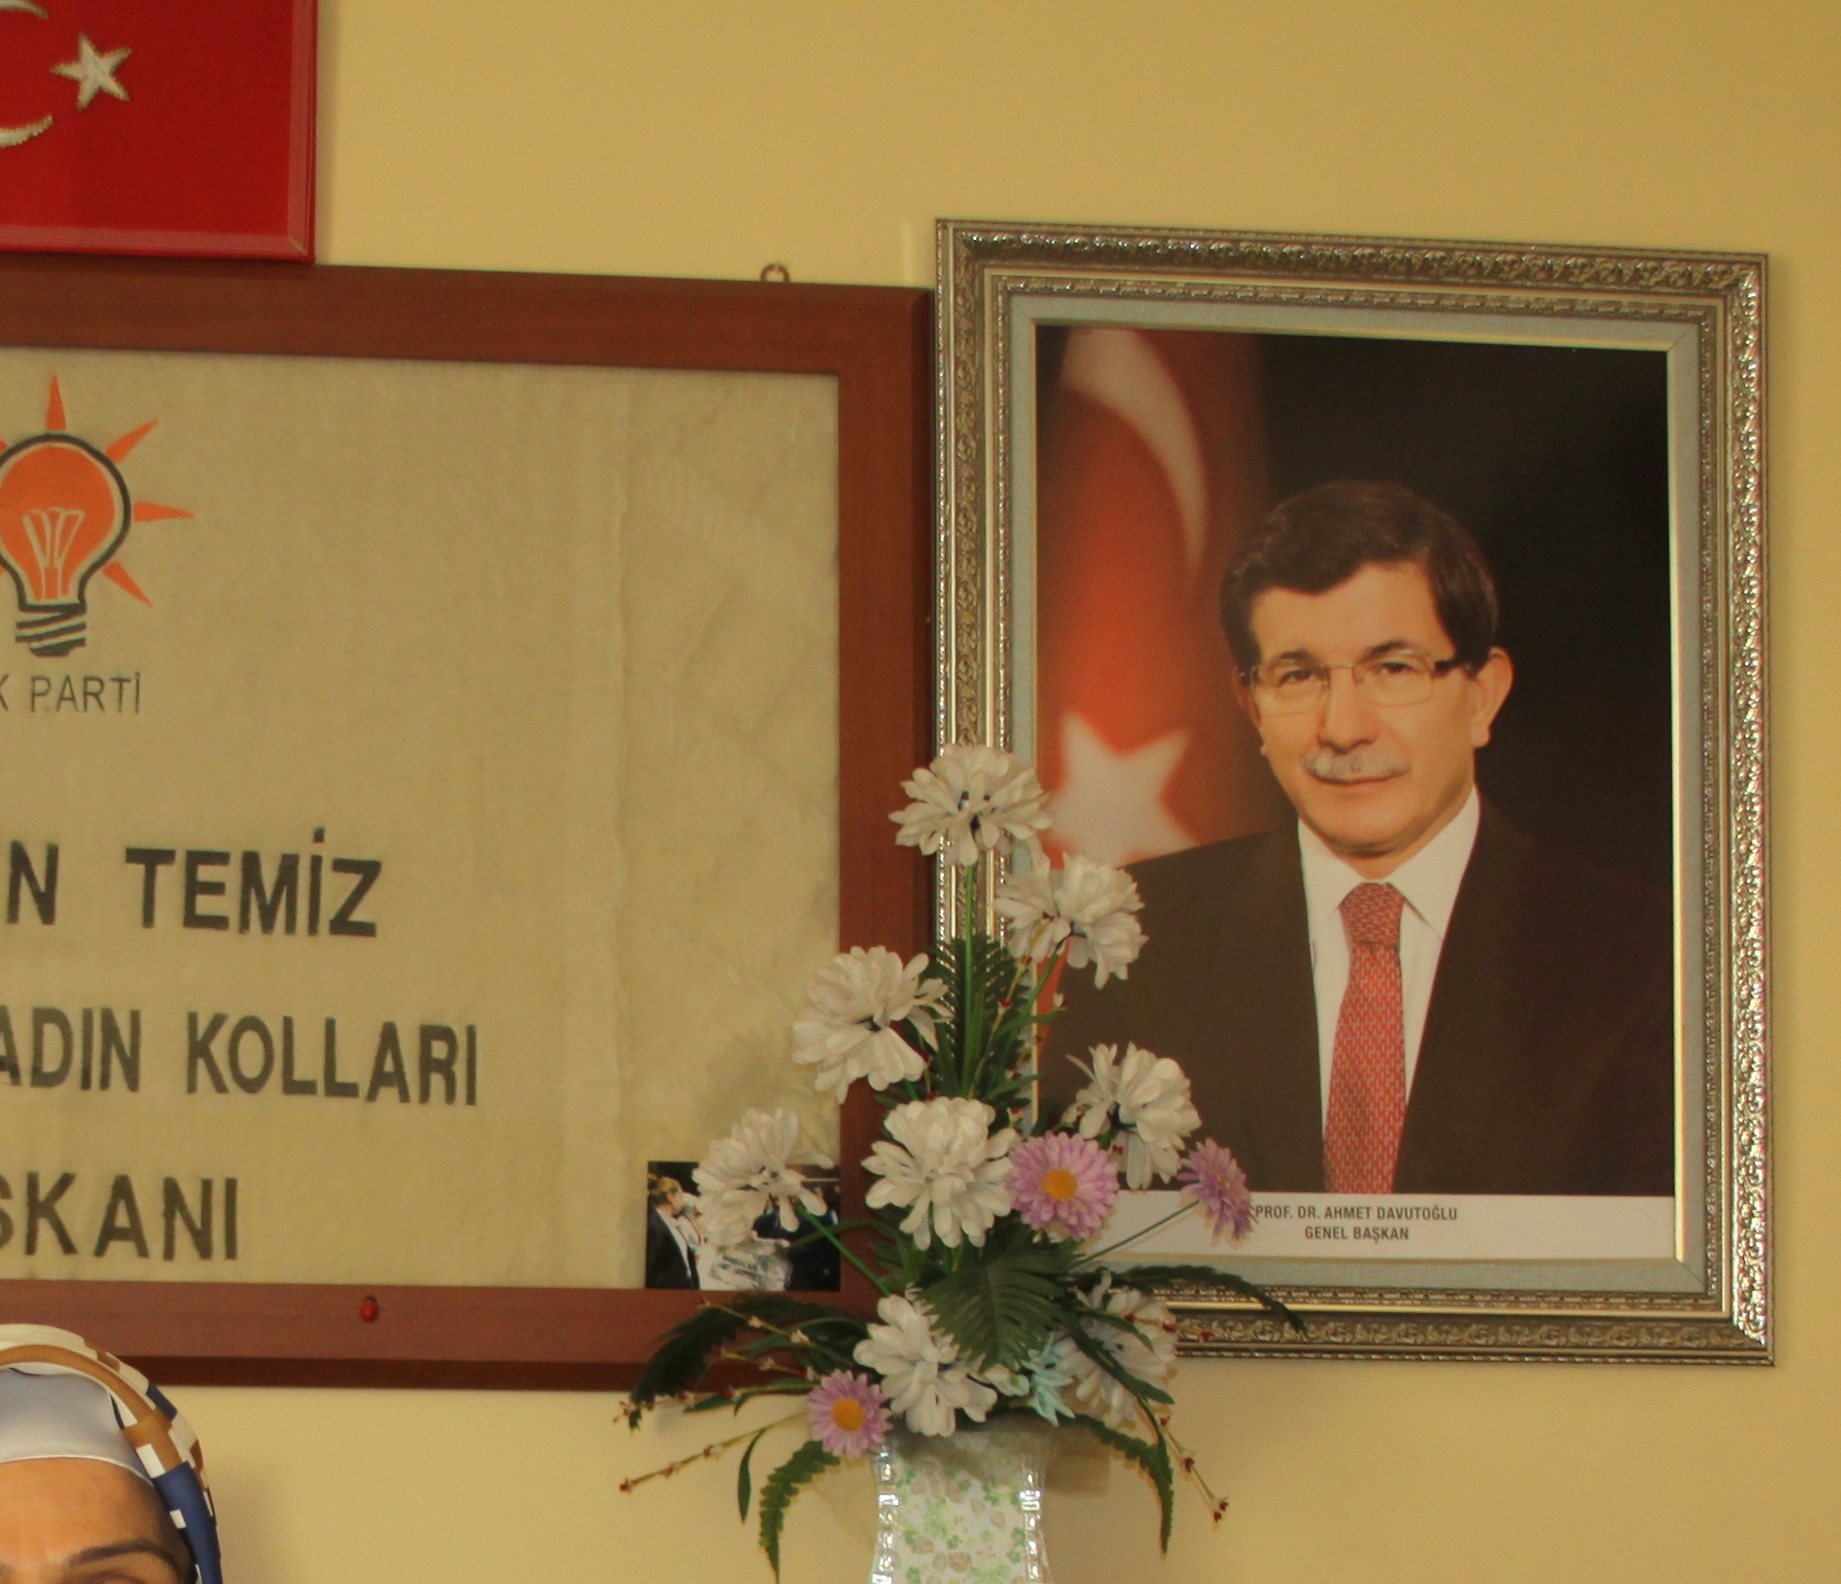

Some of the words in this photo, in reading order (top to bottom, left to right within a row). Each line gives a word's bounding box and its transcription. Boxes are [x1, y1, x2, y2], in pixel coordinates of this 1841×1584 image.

[30, 671, 141, 714] PARTİ
[125, 827, 383, 938] TEMİZ
[186, 1011, 478, 1106] KOLLARI
[1255, 1205, 1293, 1220] PROF.
[1297, 1206, 1320, 1220] DR.
[1324, 1206, 1372, 1220] AHMET
[1376, 1204, 1458, 1221] DAVUTOĞLU
[1304, 1226, 1348, 1240] GENEL
[1353, 1226, 1409, 1243] BAŞKAN
